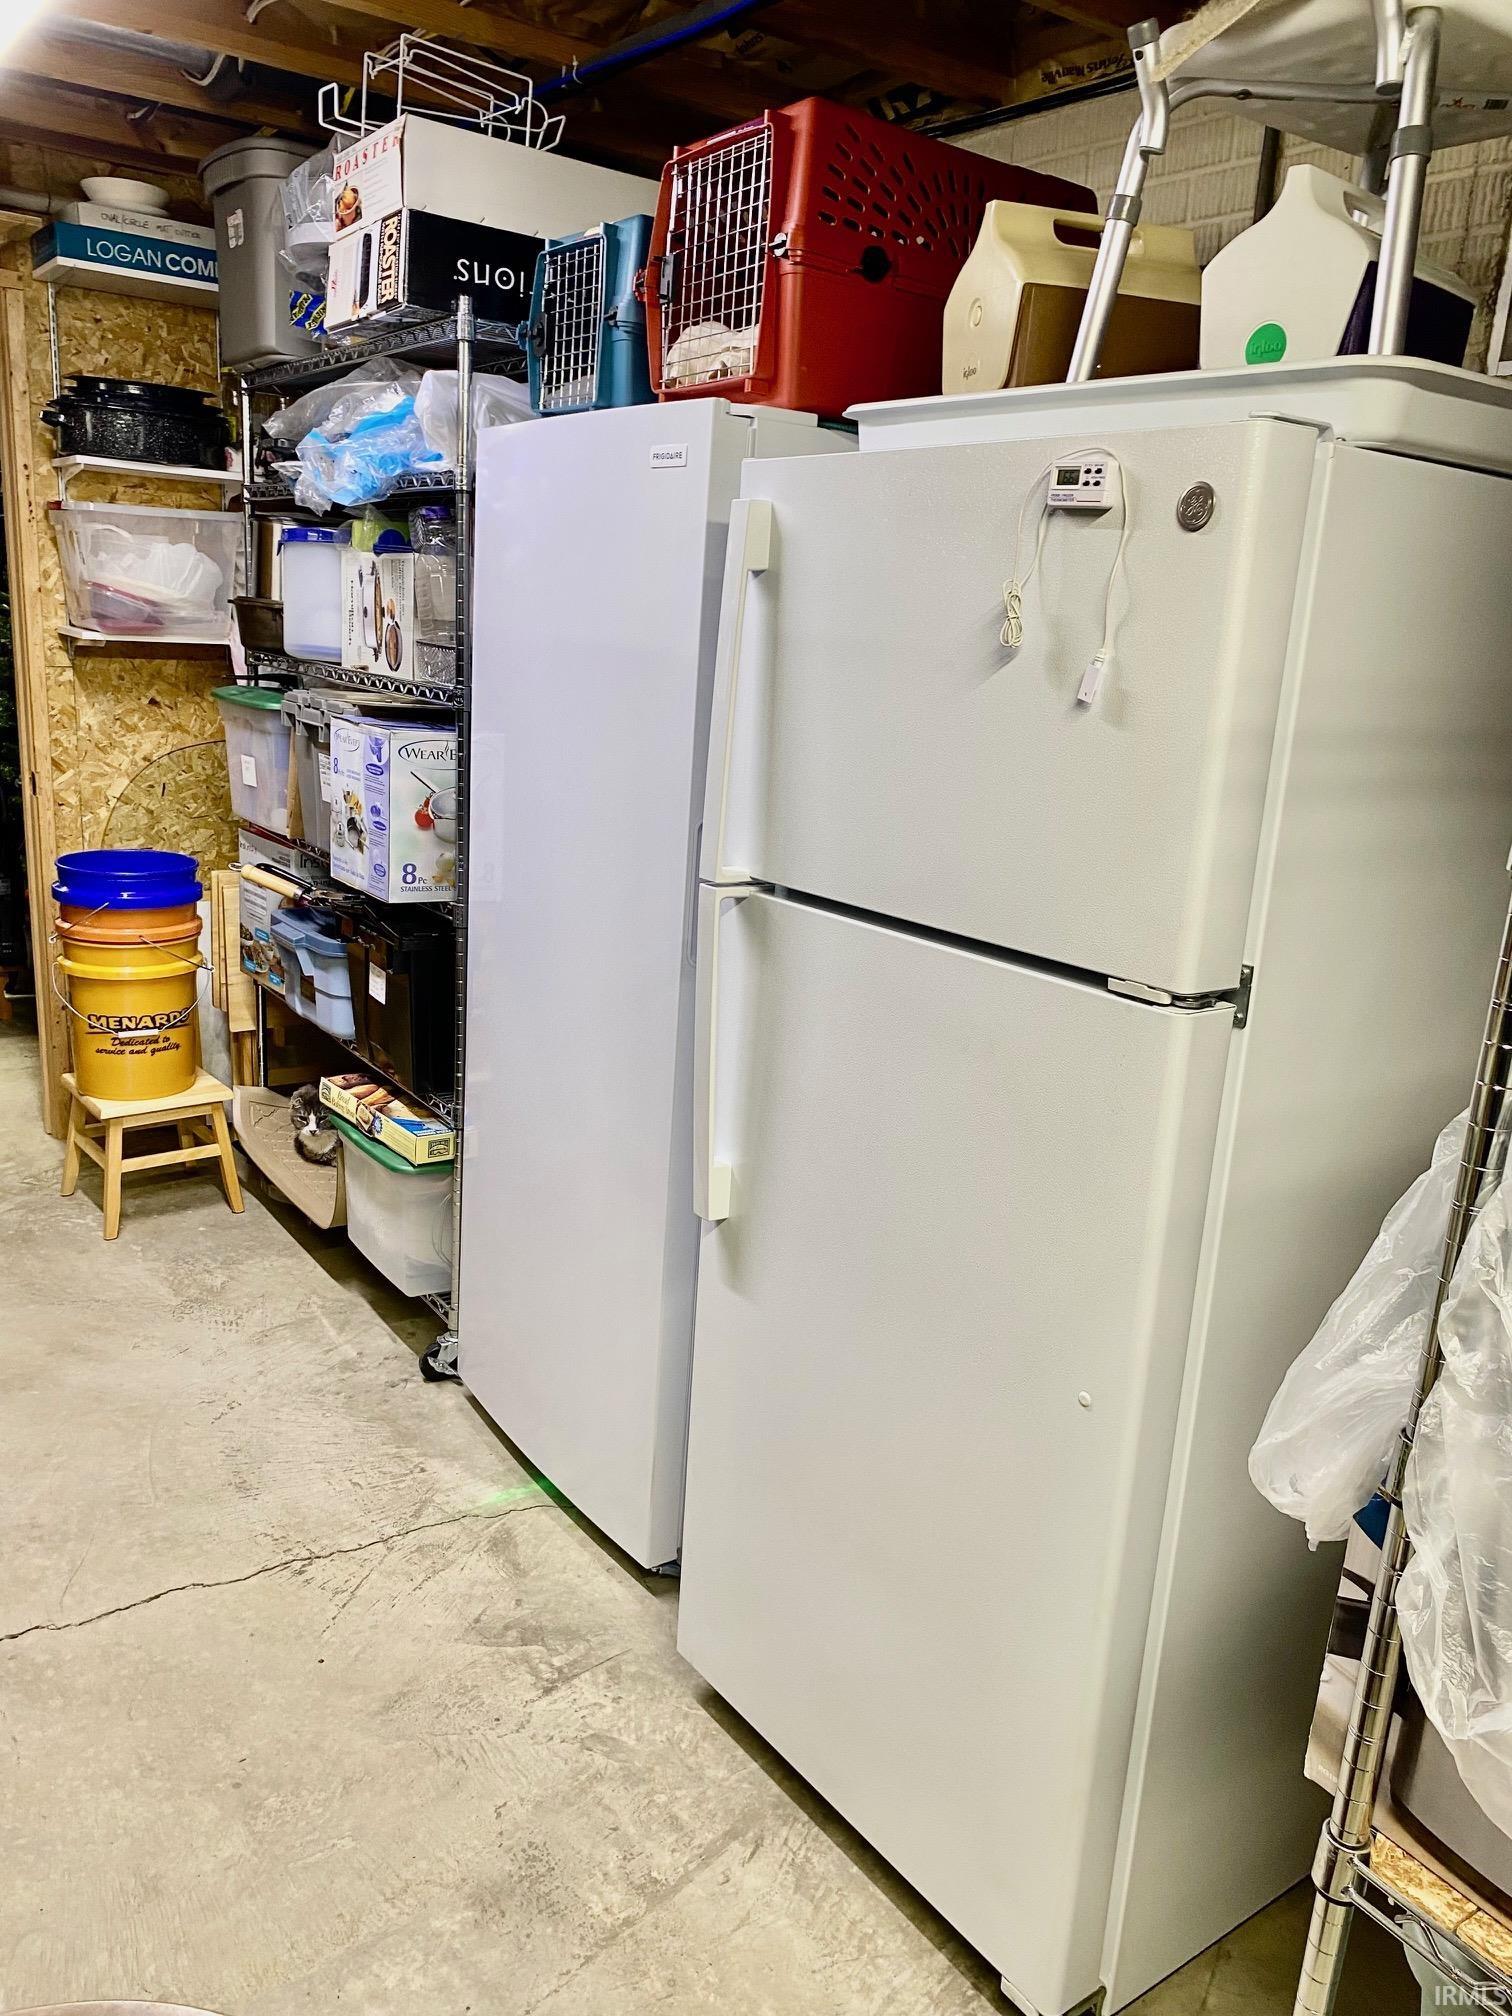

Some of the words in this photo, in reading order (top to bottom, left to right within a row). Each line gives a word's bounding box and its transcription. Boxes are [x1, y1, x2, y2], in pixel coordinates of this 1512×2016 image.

[86, 237, 163, 269] LOGAN
[380, 215, 399, 305] ROASTER
[652, 451, 683, 461] FRIGIDAIRE
[402, 863, 417, 885] 8
[417, 876, 428, 885] Pc
[400, 885, 433, 893] STAINLESS
[95, 1046, 126, 1056] service
[128, 1045, 148, 1055] and
[150, 1041, 182, 1057] quality
[110, 1036, 160, 1047] Dedicated
[162, 1035, 171, 1043] to
